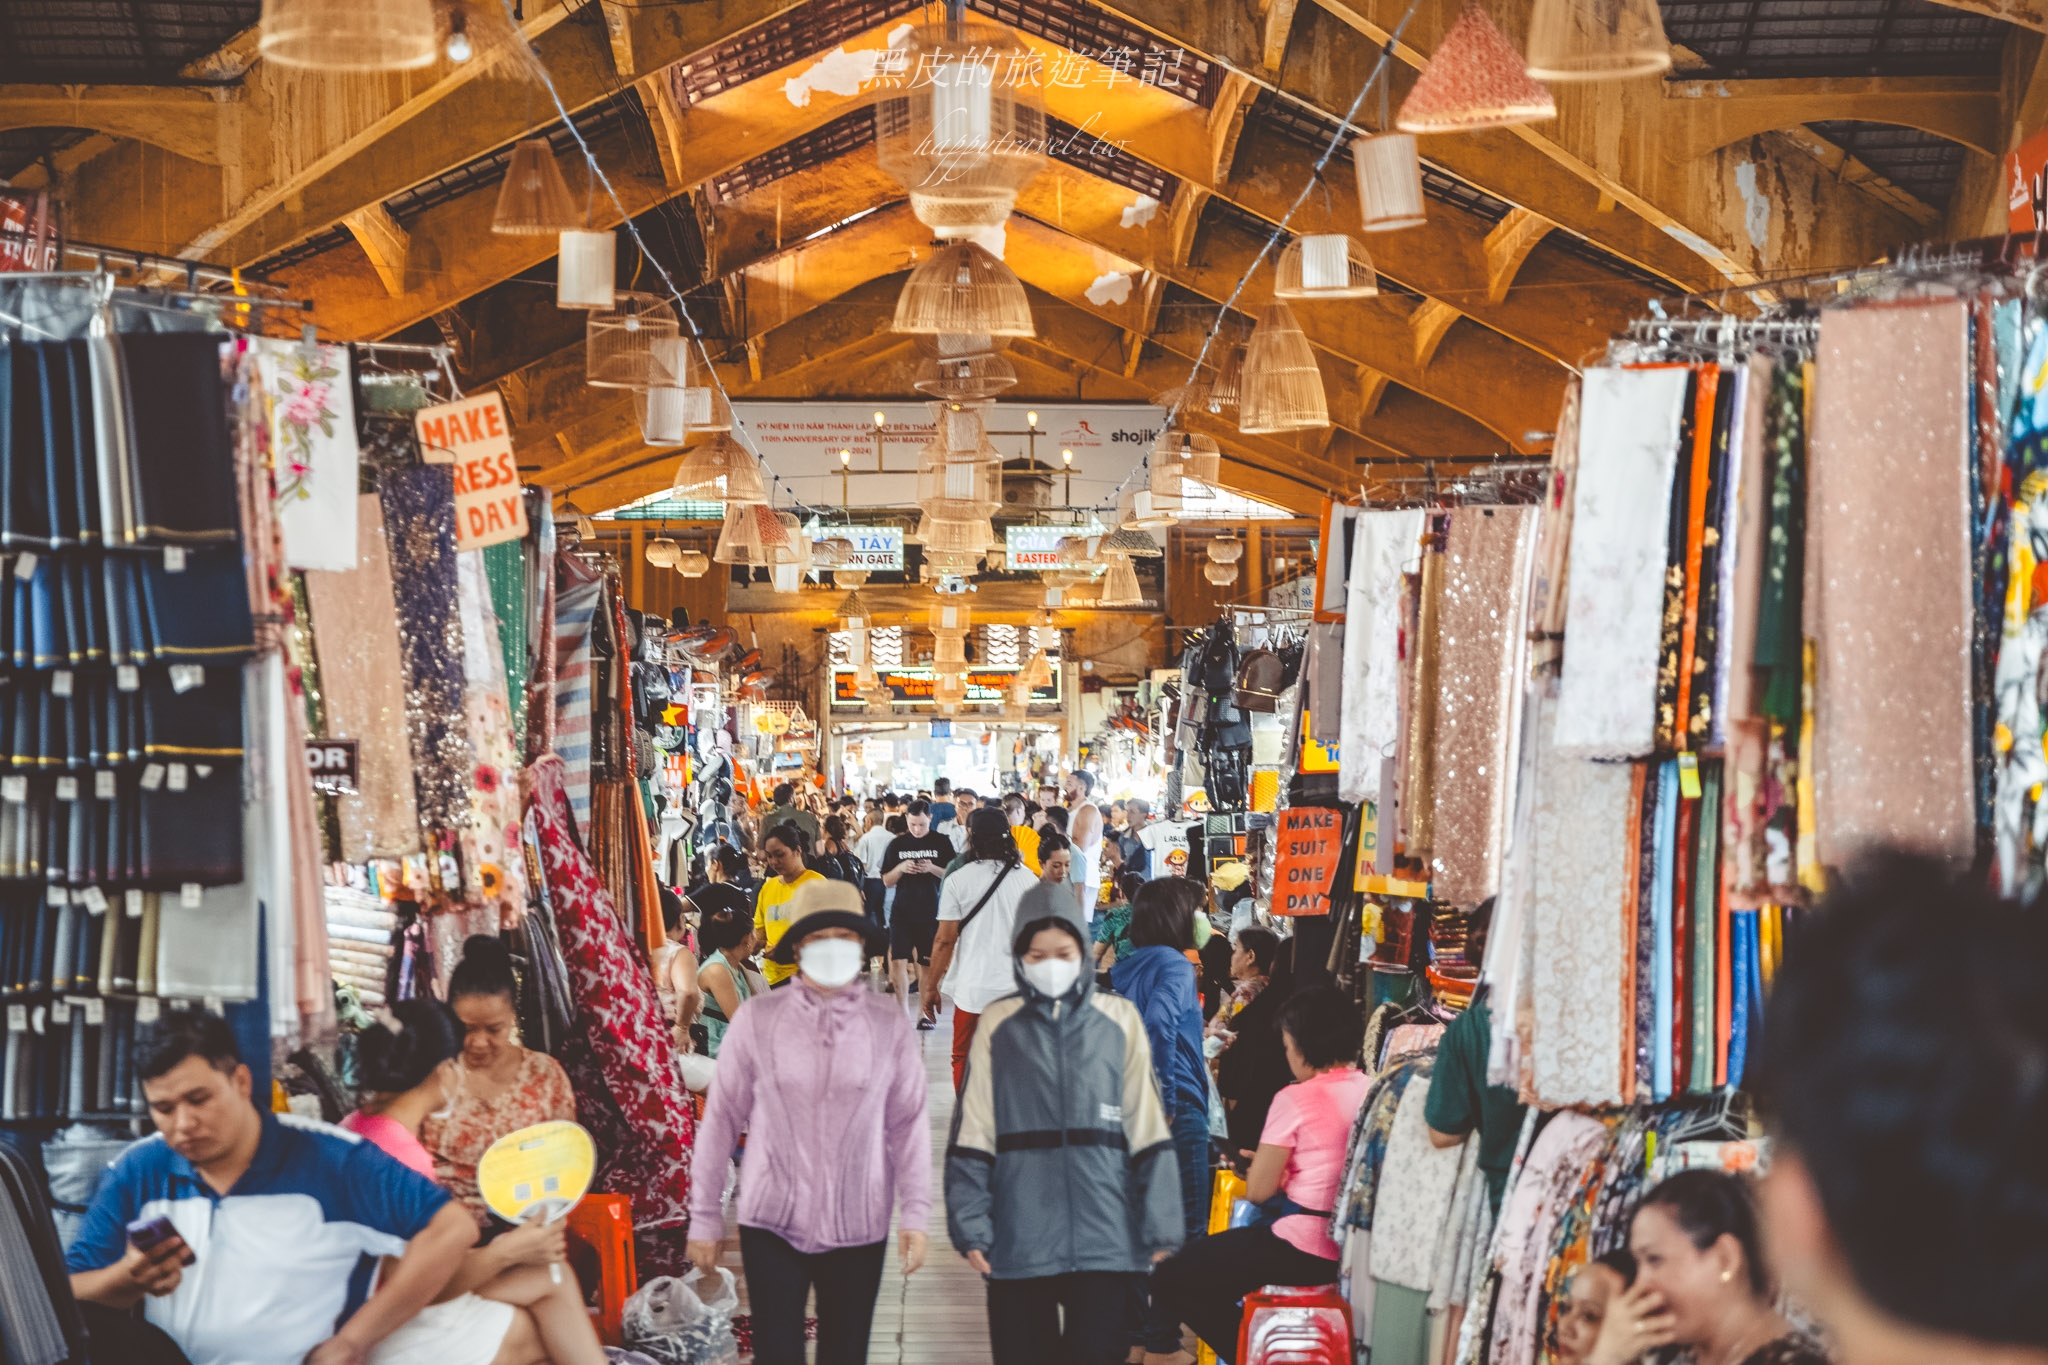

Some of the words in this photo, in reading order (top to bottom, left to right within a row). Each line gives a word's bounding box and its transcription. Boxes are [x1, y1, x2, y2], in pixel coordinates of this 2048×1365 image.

[422, 404, 503, 451] MAKE
[782, 434, 839, 443] ANNIVERSARY
[873, 435, 900, 443] TANH
[454, 452, 514, 496] RESS
[468, 496, 519, 538] DAY
[860, 534, 893, 549] TÂY
[867, 554, 894, 564] GATE
[1016, 553, 1060, 564] EASTER
[304, 747, 348, 769] OR
[1287, 813, 1334, 830] MAKE
[898, 849, 938, 859] ESSENTIALS
[1290, 839, 1327, 857] SUIT
[1288, 867, 1325, 883] ONE
[1287, 894, 1323, 909] DAY
